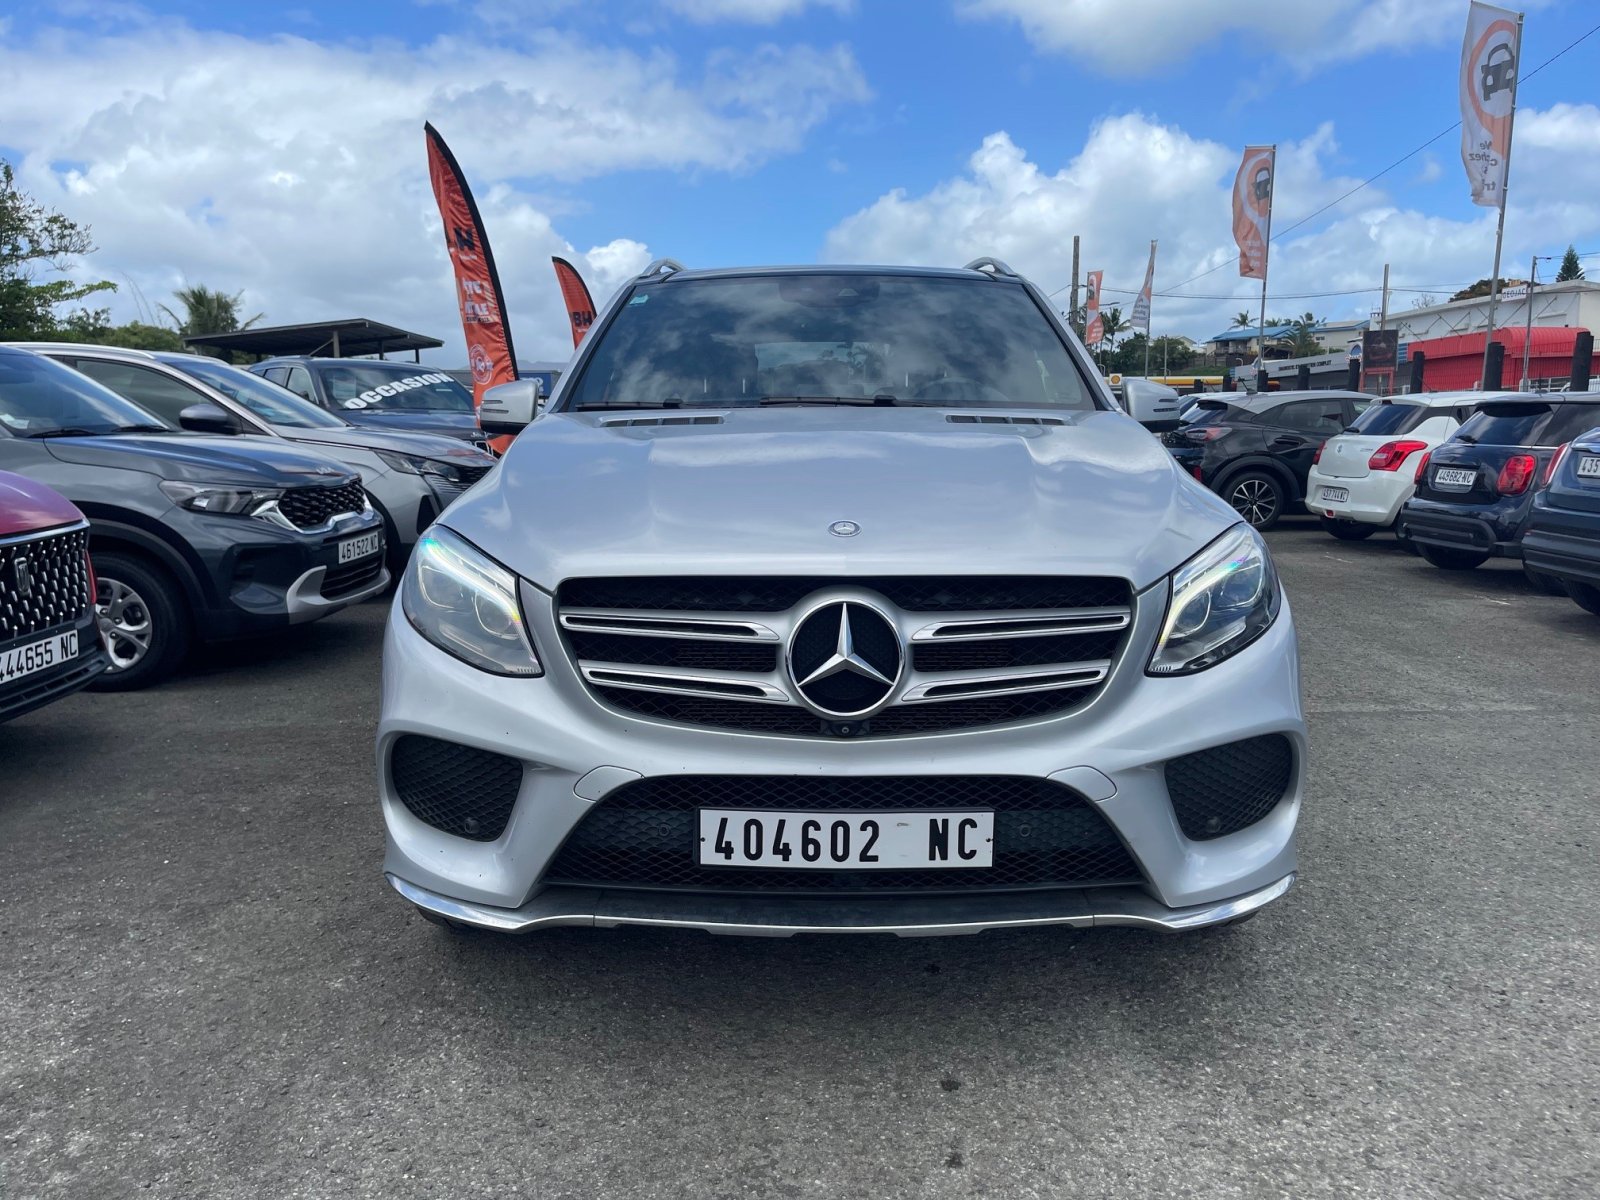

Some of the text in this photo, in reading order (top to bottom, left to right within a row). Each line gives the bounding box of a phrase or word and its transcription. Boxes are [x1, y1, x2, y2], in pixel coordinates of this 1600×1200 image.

[344, 373, 455, 410] OCCASION
[341, 534, 378, 560] 461522 NC
[61, 633, 77, 660] NC
[714, 817, 978, 863] 404602 NC
